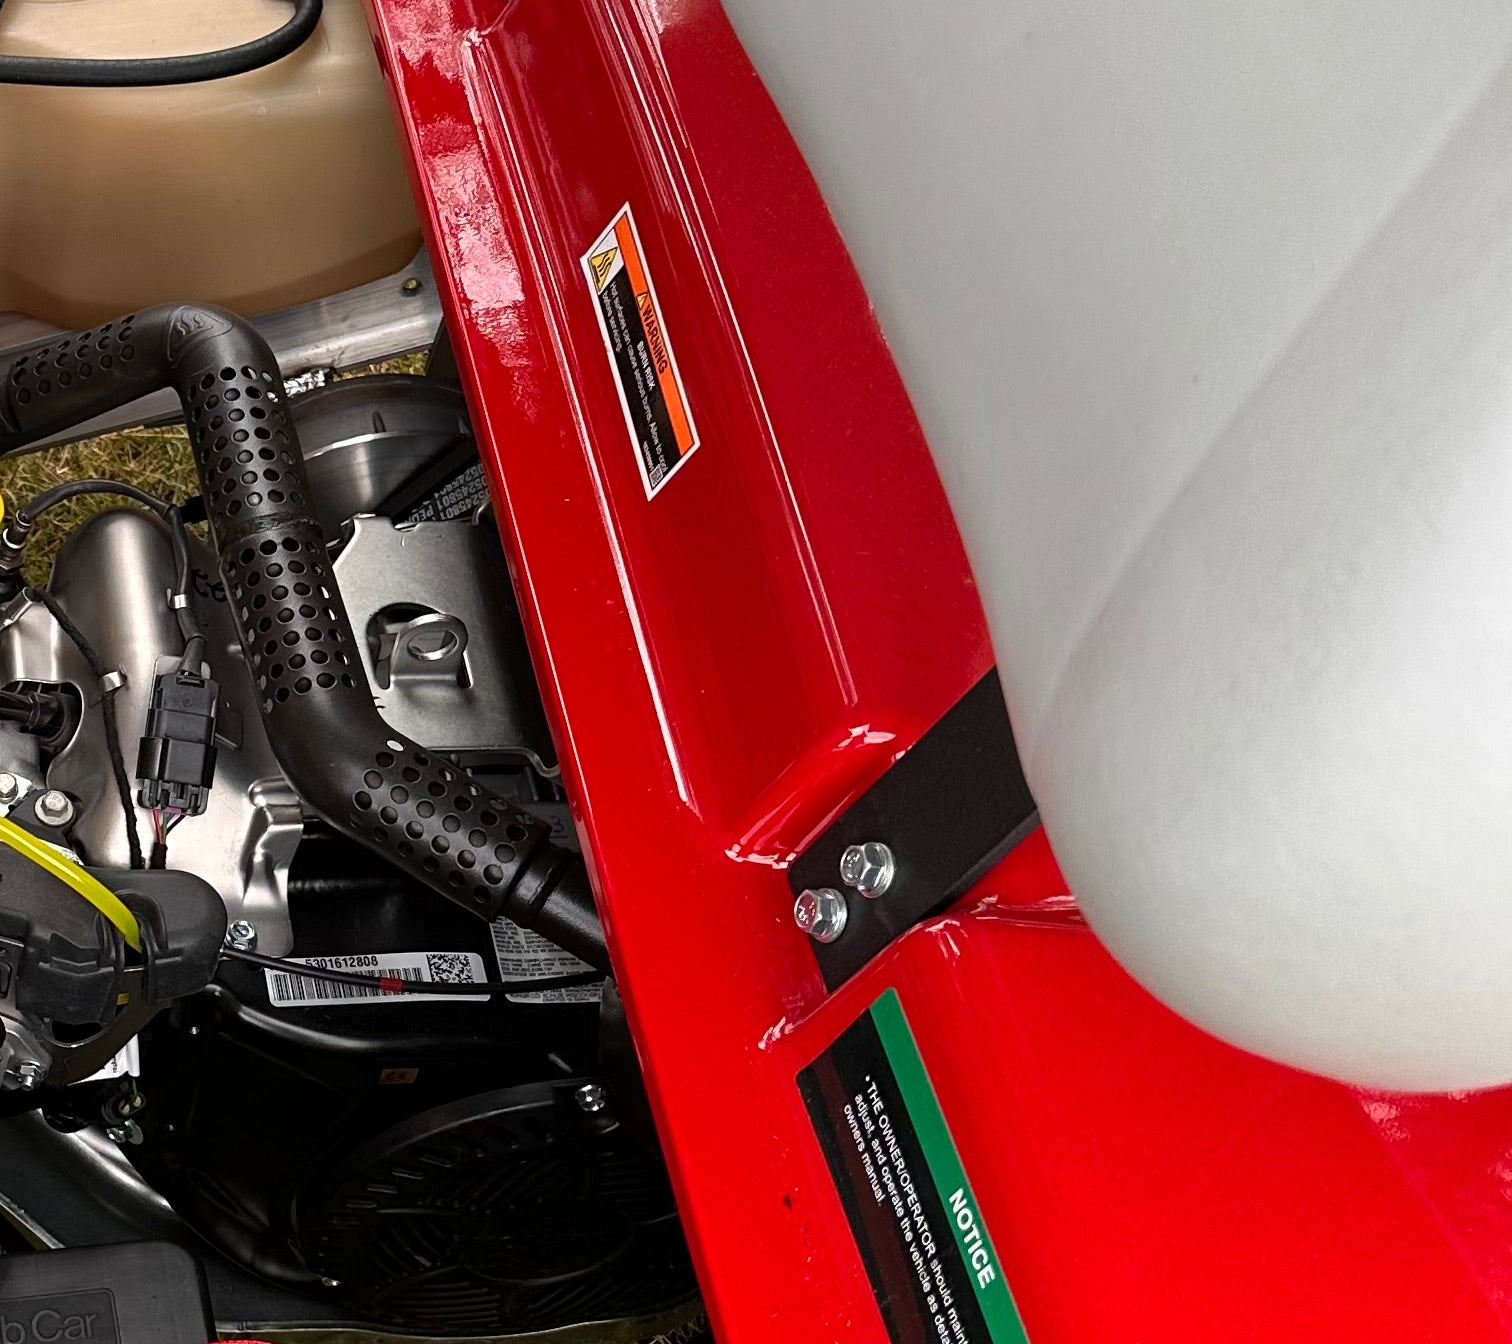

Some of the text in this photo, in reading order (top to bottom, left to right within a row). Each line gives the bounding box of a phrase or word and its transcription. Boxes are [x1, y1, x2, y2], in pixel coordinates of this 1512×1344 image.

[602, 290, 613, 317] before
[609, 281, 619, 299] Hot
[613, 296, 627, 331] surfaces
[622, 328, 631, 346] can
[642, 304, 668, 374] WARNING
[627, 344, 638, 369] cause
[637, 340, 656, 391] BURN RISK
[633, 368, 646, 399] serious
[648, 421, 659, 446] Allow
[655, 443, 663, 455] to
[658, 454, 669, 473] cool
[305, 955, 379, 970] 5301612808
[843, 1104, 886, 1206] owners manual.
[867, 1081, 884, 1115] THE
[879, 1115, 936, 1258] OWNER/OPERATOR
[928, 1259, 954, 1307] should
[871, 1138, 887, 1165] and
[881, 1166, 905, 1217] operate
[900, 1217, 913, 1242] the
[909, 1242, 931, 1293] vehicle
[926, 1294, 939, 1314] as
[949, 1188, 995, 1288] NOTICE
[31, 1309, 97, 1344] Car
